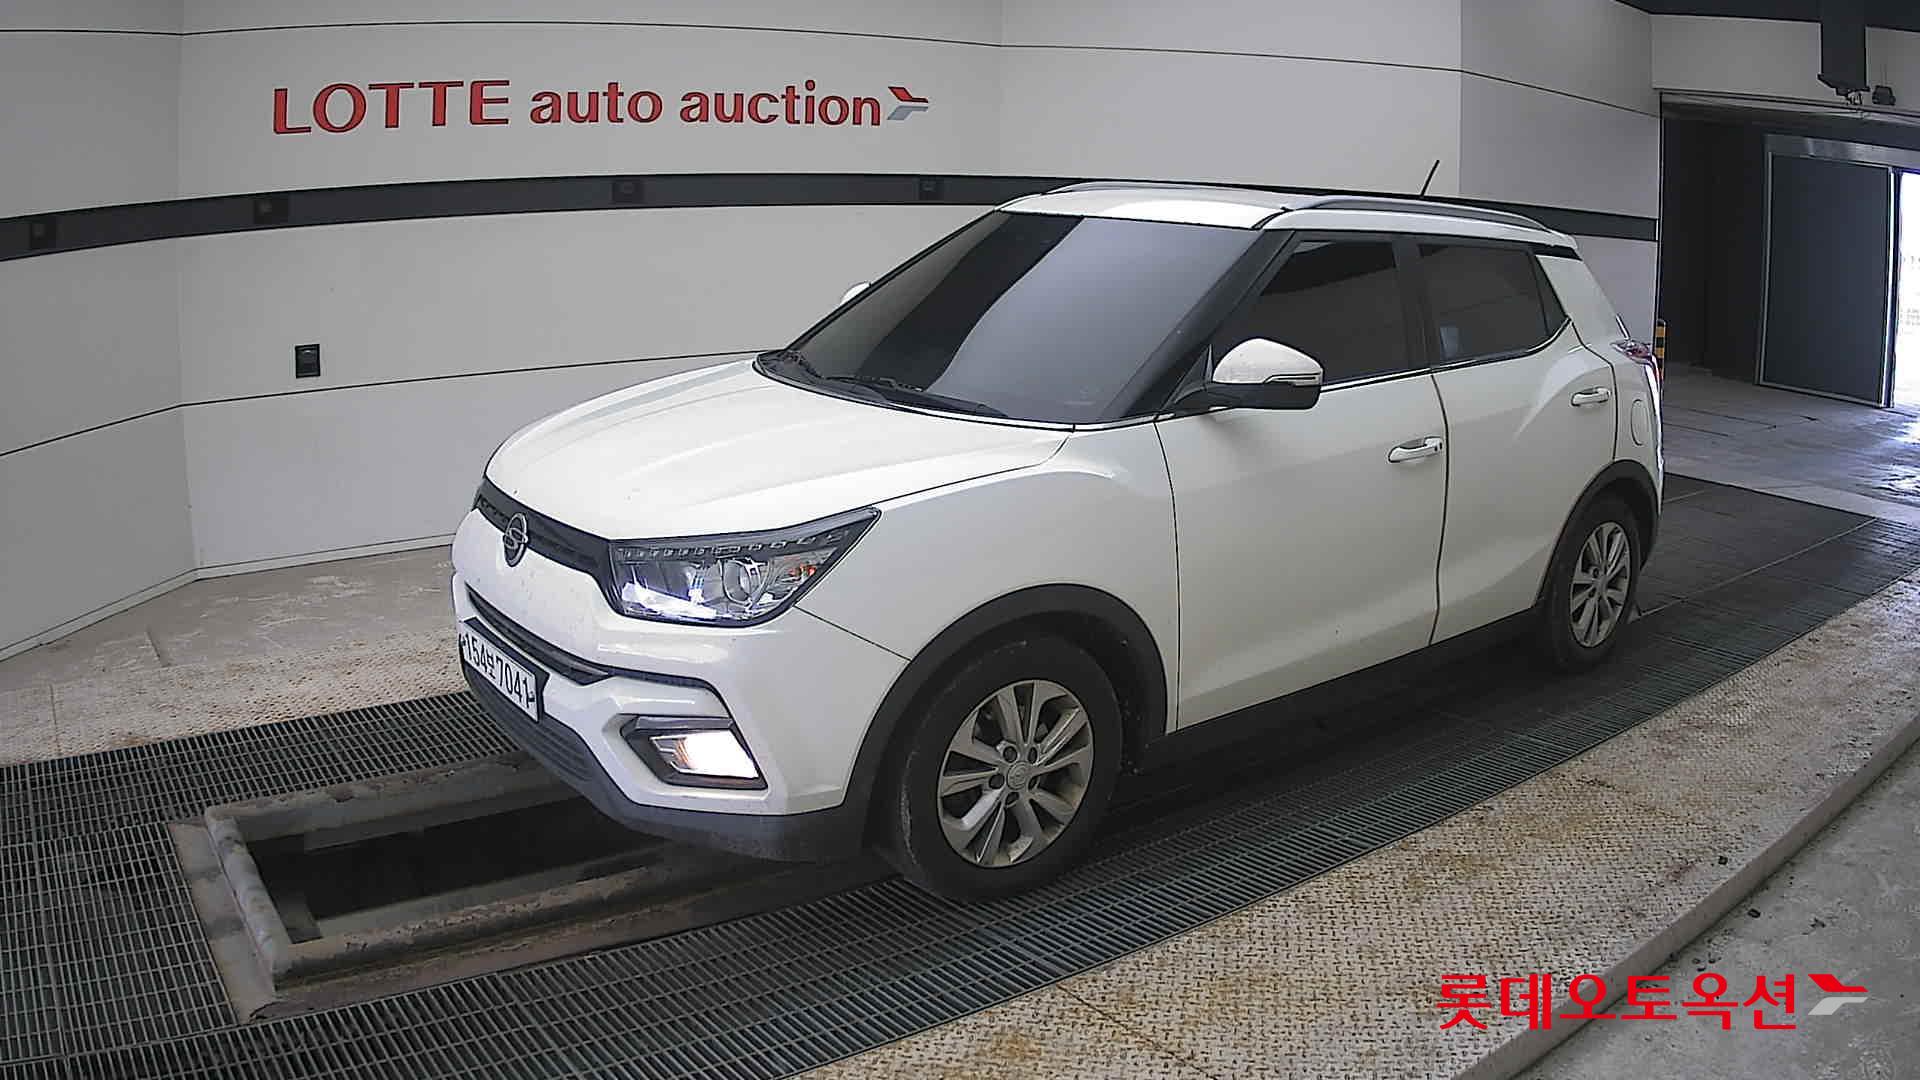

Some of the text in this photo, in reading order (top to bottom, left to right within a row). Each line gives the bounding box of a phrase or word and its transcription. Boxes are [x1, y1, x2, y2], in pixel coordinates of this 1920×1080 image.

[273, 80, 881, 134] LOTTE auto auction
